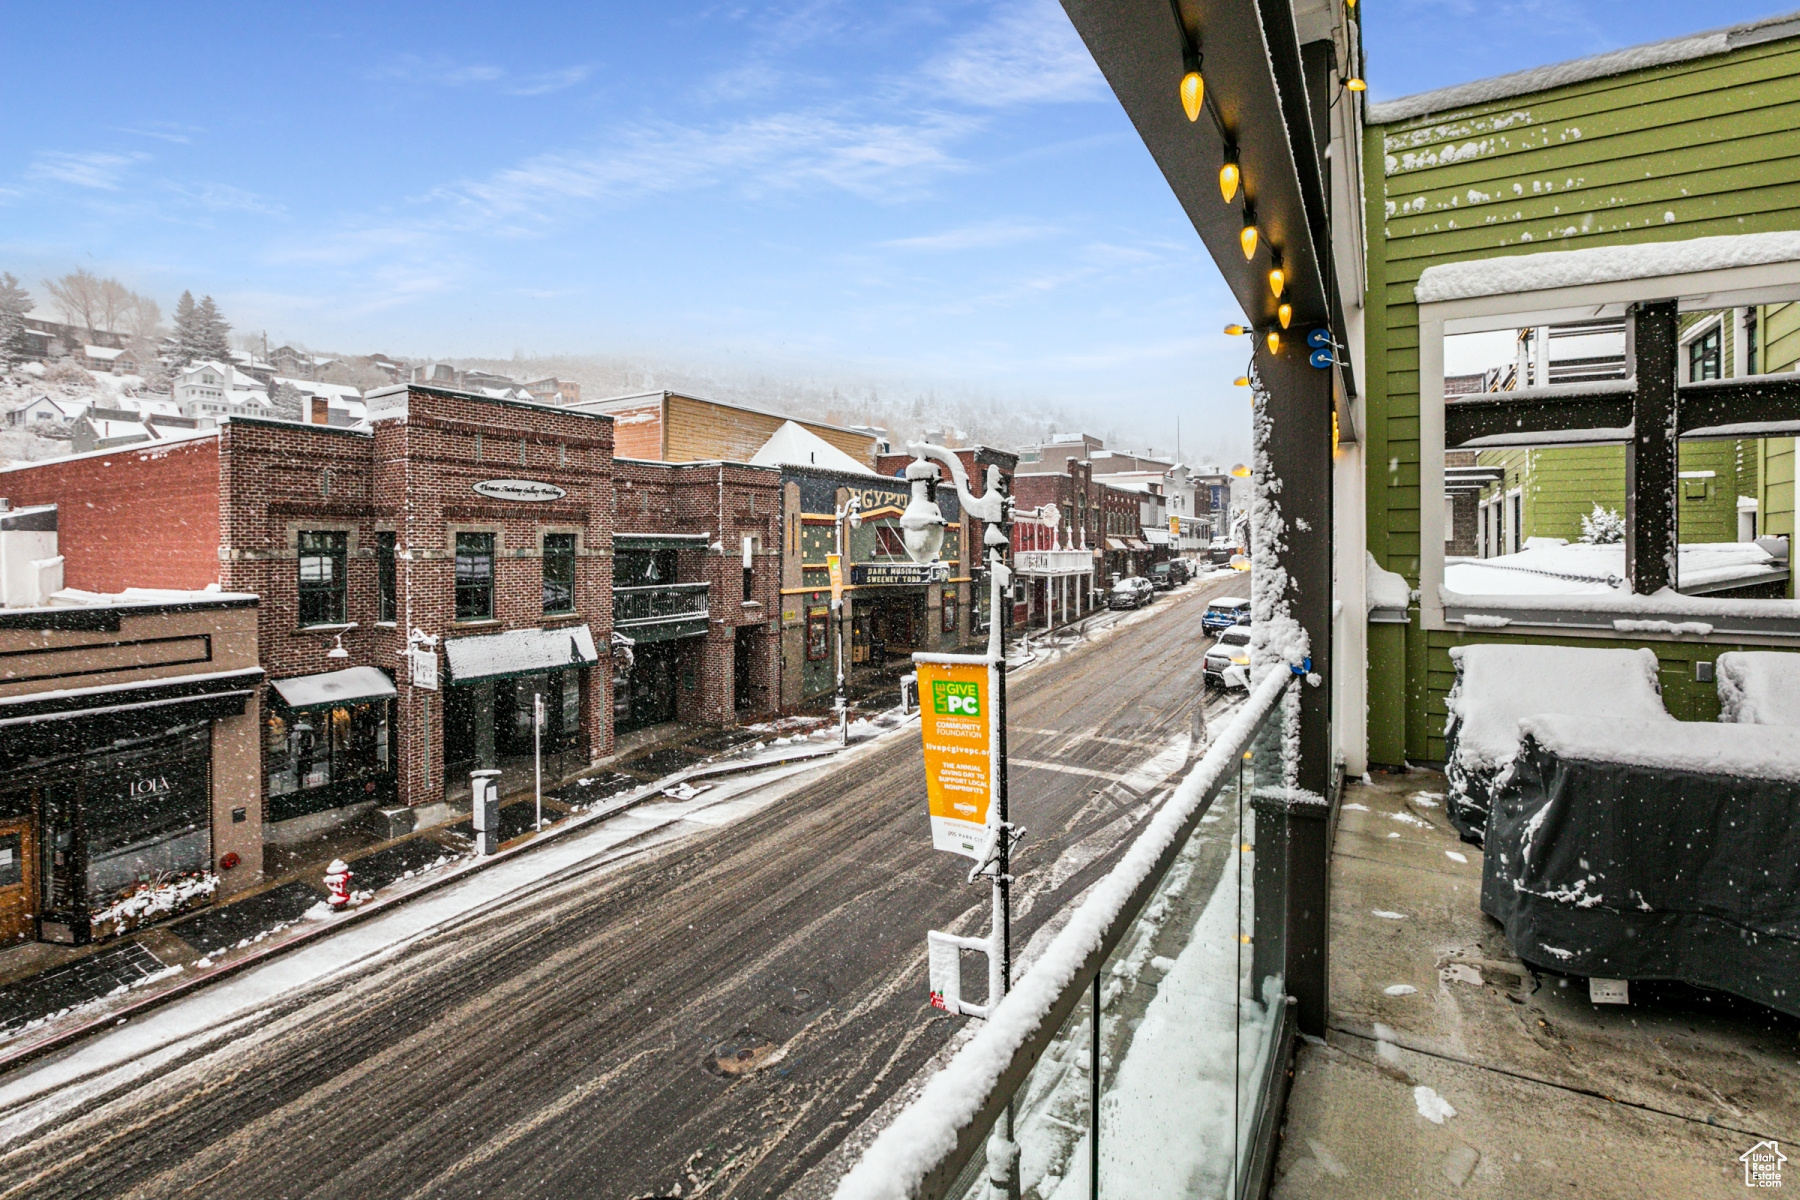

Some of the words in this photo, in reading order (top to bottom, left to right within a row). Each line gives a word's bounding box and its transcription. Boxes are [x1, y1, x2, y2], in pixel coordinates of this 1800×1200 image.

[847, 487, 912, 509] EGYPTI
[890, 567, 921, 575] MUSICAL
[866, 575, 898, 583] SWEENEY
[946, 683, 976, 695] GIVE
[936, 683, 947, 712] LIVE
[948, 695, 978, 714] PC
[936, 721, 981, 731] COMMUNITY
[936, 728, 982, 738] FOUNDATION
[926, 743, 990, 756] livepcgivepc.or
[956, 763, 982, 772] ANNUAL
[940, 769, 962, 777] GIVING
[938, 776, 967, 784] SUPPORT
[968, 780, 988, 788] LOCAL
[944, 784, 984, 794] NONPROFITS
